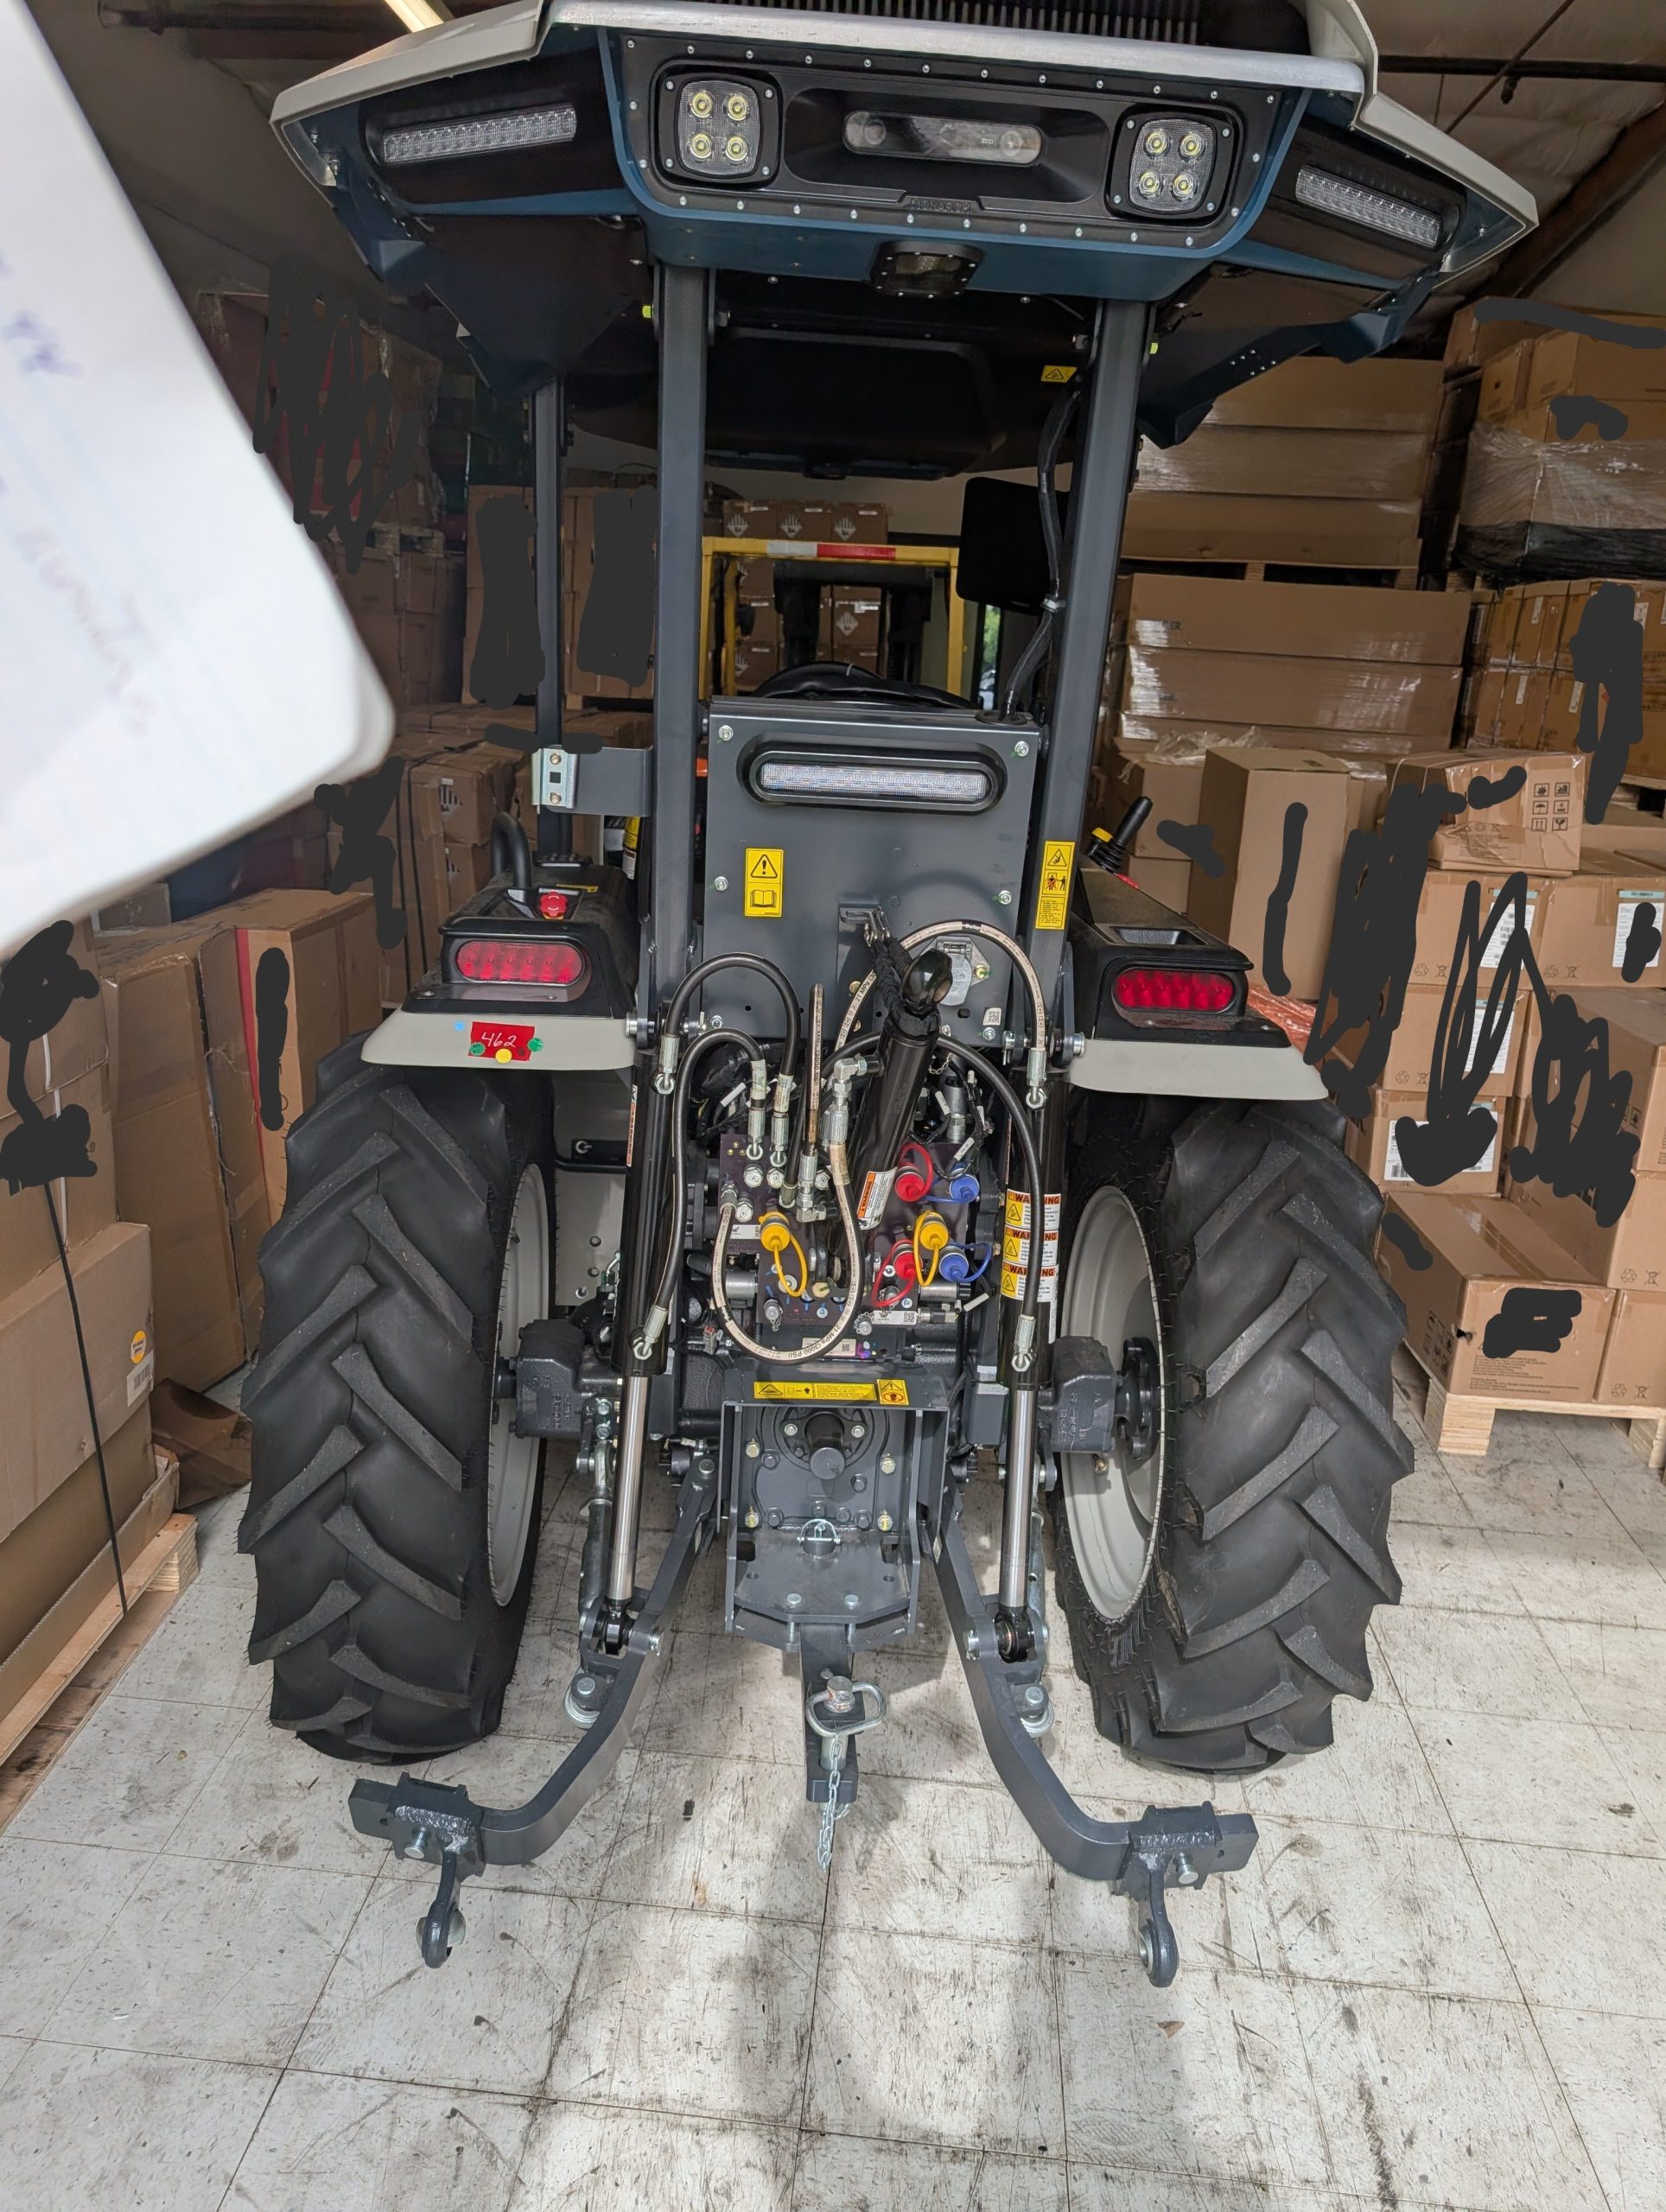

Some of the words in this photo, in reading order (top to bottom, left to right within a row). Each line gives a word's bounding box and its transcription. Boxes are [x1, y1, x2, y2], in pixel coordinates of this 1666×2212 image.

[481, 1032, 517, 1048] 462
[862, 1181, 873, 1207] WARNING
[834, 1324, 842, 1333] 21
[822, 1332, 836, 1344] MPa
[787, 1349, 802, 1359] PSI)
[804, 1343, 822, 1354] (3000
